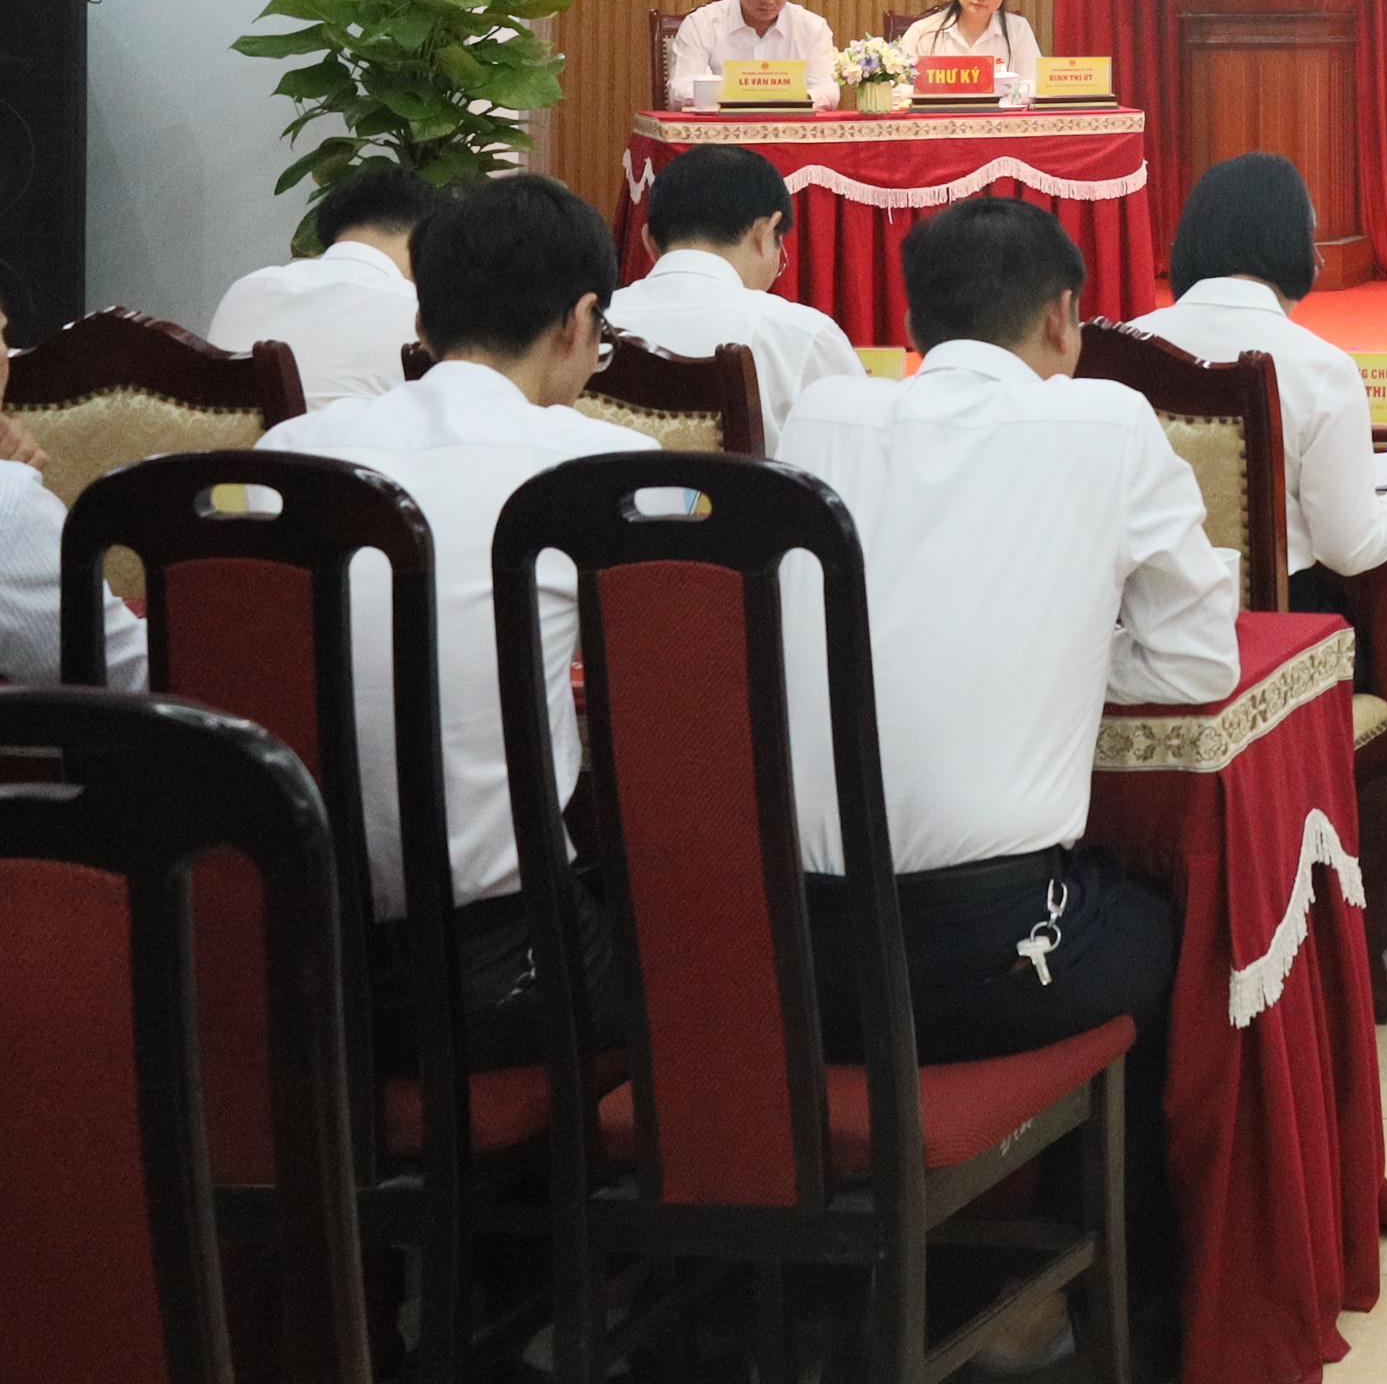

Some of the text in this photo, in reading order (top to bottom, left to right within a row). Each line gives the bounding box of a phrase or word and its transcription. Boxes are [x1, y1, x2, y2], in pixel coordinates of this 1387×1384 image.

[927, 66, 981, 83] THƯ KÝ
[1365, 386, 1386, 400] THỊ
